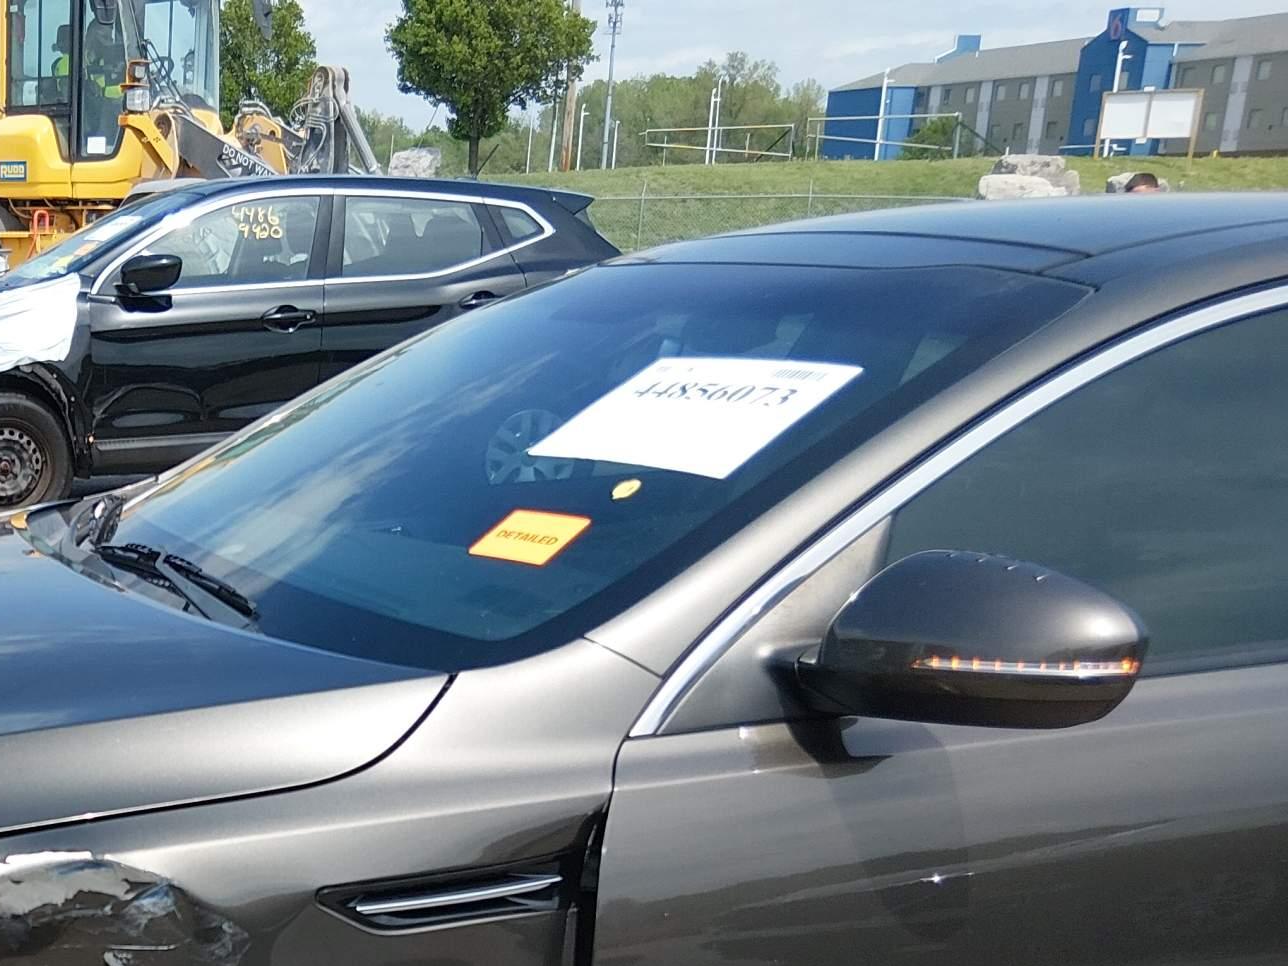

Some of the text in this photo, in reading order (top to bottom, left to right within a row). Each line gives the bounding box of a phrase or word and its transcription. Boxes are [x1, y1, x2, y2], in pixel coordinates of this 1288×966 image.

[222, 144, 236, 158] DO
[236, 152, 255, 171] NOT
[0, 164, 25, 179] RUDD
[633, 381, 798, 407] 44856073
[495, 529, 559, 546] DETAILED
